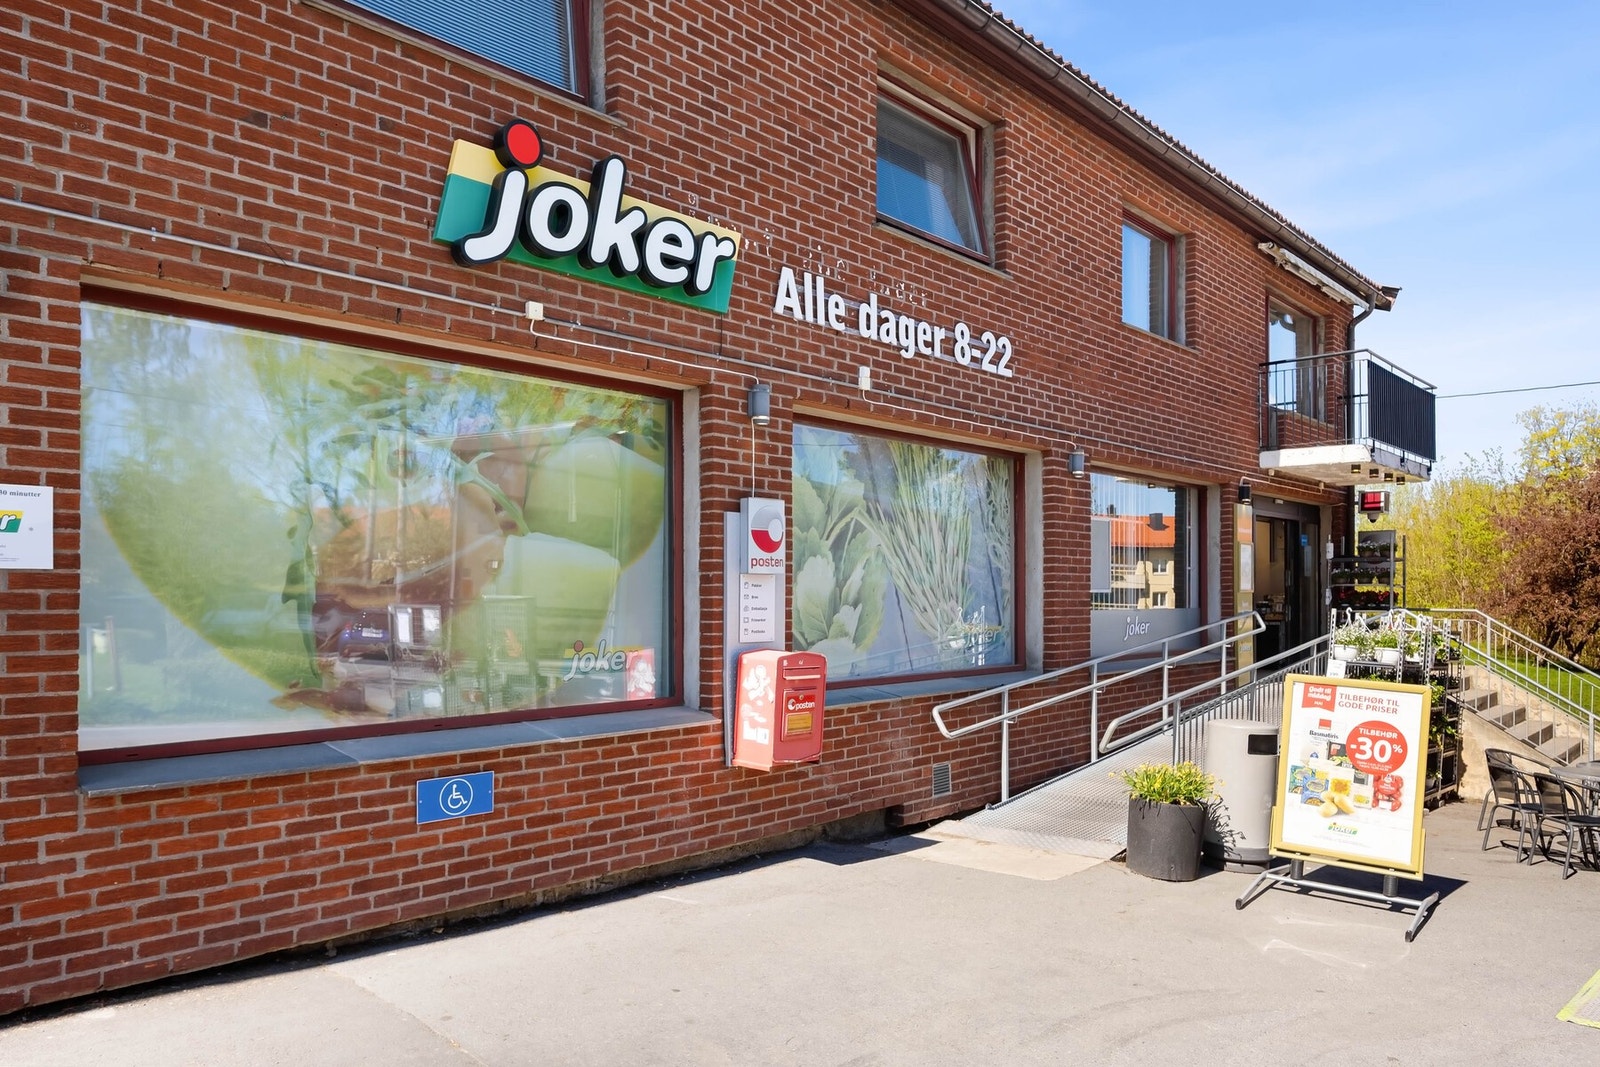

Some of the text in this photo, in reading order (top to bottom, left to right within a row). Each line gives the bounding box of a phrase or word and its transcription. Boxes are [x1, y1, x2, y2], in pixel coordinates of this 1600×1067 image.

[452, 119, 737, 297] joker
[773, 266, 1013, 378] Alle dager 8-22
[10, 490, 42, 498] minutter
[750, 556, 784, 569] posten
[1124, 615, 1151, 641] joker
[563, 639, 639, 682] joker
[795, 701, 816, 711] posten
[1338, 693, 1400, 707] TILBEHØR TIL
[1338, 701, 1398, 715] GODE PRISER
[1359, 727, 1398, 739] TILBEHØR
